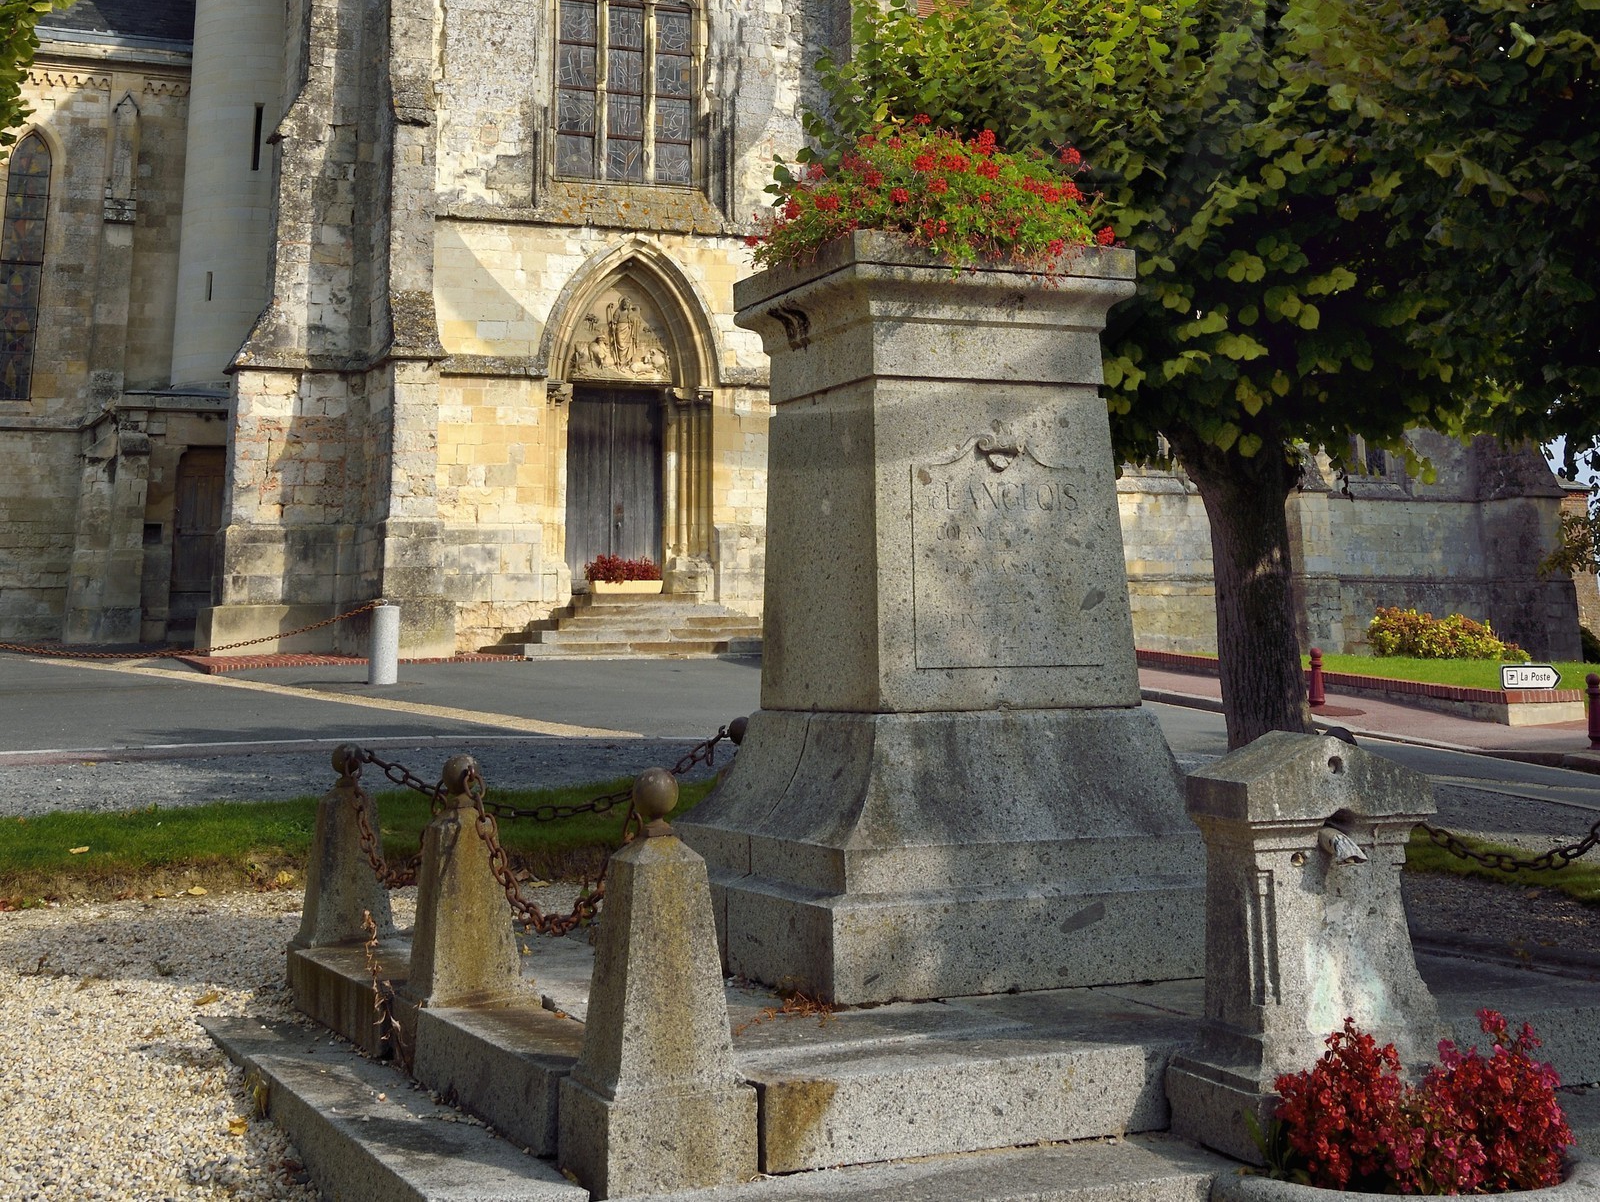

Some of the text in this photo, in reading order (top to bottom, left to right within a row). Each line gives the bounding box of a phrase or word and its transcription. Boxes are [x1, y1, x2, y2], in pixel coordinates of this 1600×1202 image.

[944, 481, 1079, 512] LANGLOIS
[1520, 671, 1551, 682] La Poste
